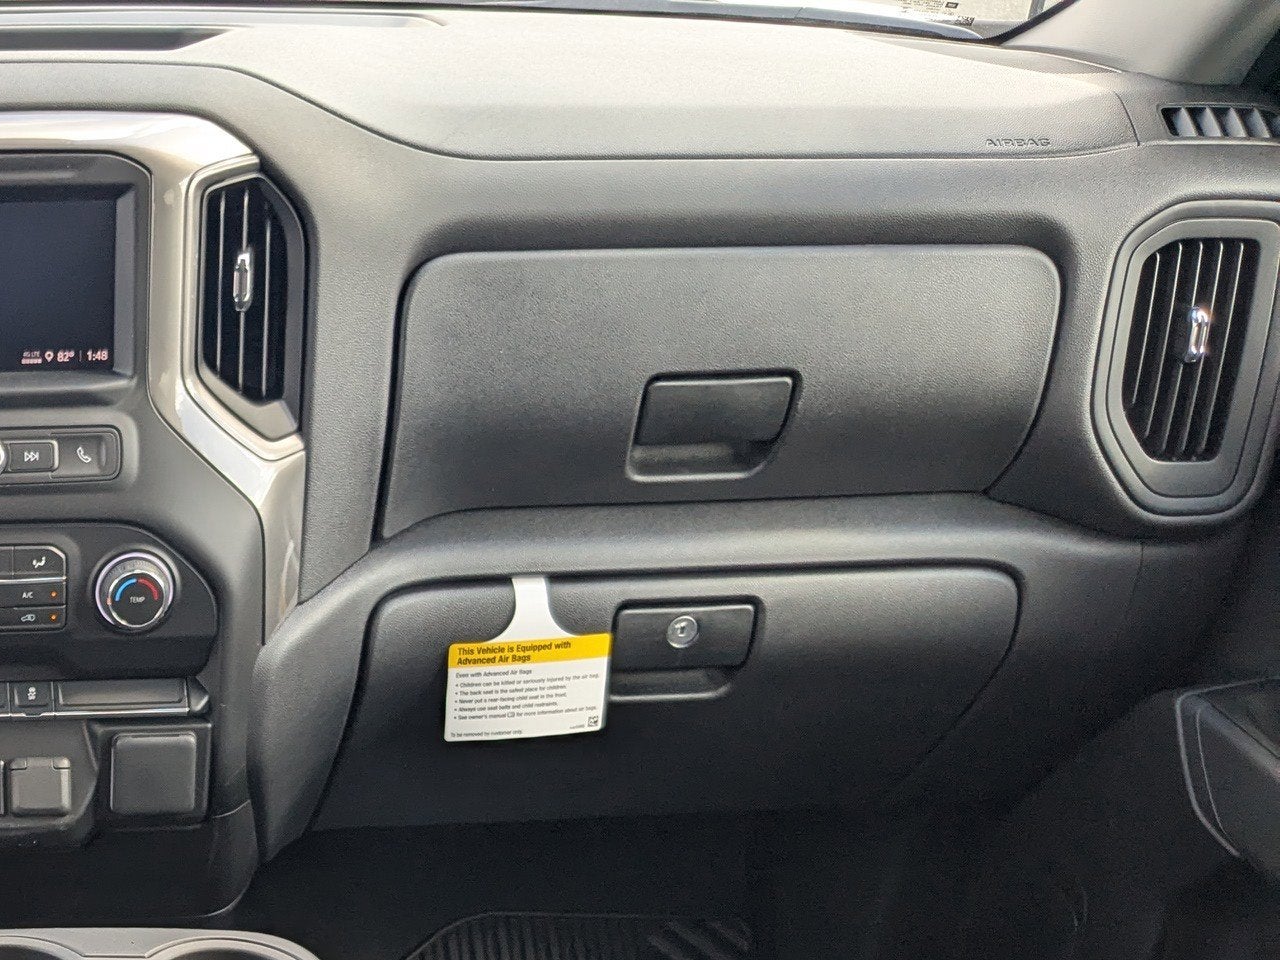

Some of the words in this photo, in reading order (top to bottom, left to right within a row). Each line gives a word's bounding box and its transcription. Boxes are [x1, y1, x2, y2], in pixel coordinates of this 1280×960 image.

[985, 138, 1051, 147] AIRBAG
[87, 349, 108, 361] 1:48
[458, 647, 474, 655] This
[477, 645, 505, 654] Vehicle
[516, 643, 552, 653] Equipped
[554, 641, 571, 649] with
[457, 656, 496, 665] Advanced
[498, 655, 510, 663] Air
[512, 654, 531, 663] Bags
